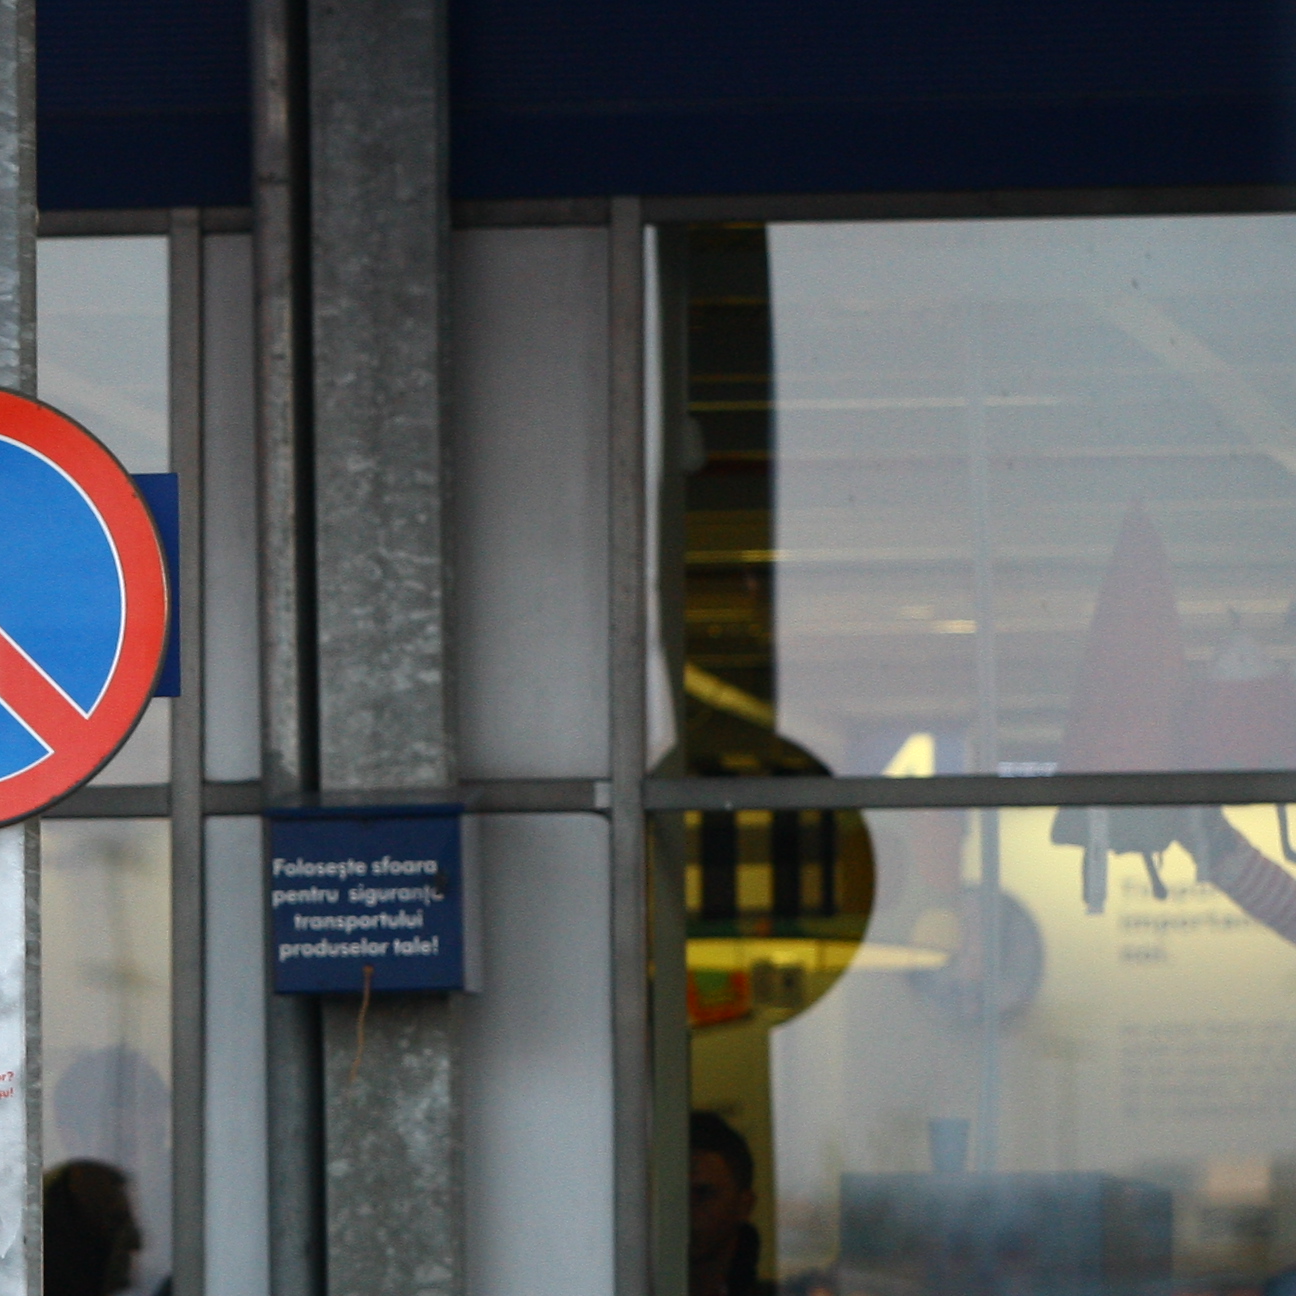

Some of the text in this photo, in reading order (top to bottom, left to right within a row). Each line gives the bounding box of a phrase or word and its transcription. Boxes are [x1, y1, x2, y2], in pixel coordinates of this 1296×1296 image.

[371, 854, 438, 876] sfoara
[271, 886, 339, 909] pentru
[293, 909, 424, 934] transportului
[278, 935, 439, 963] produselor tale!
